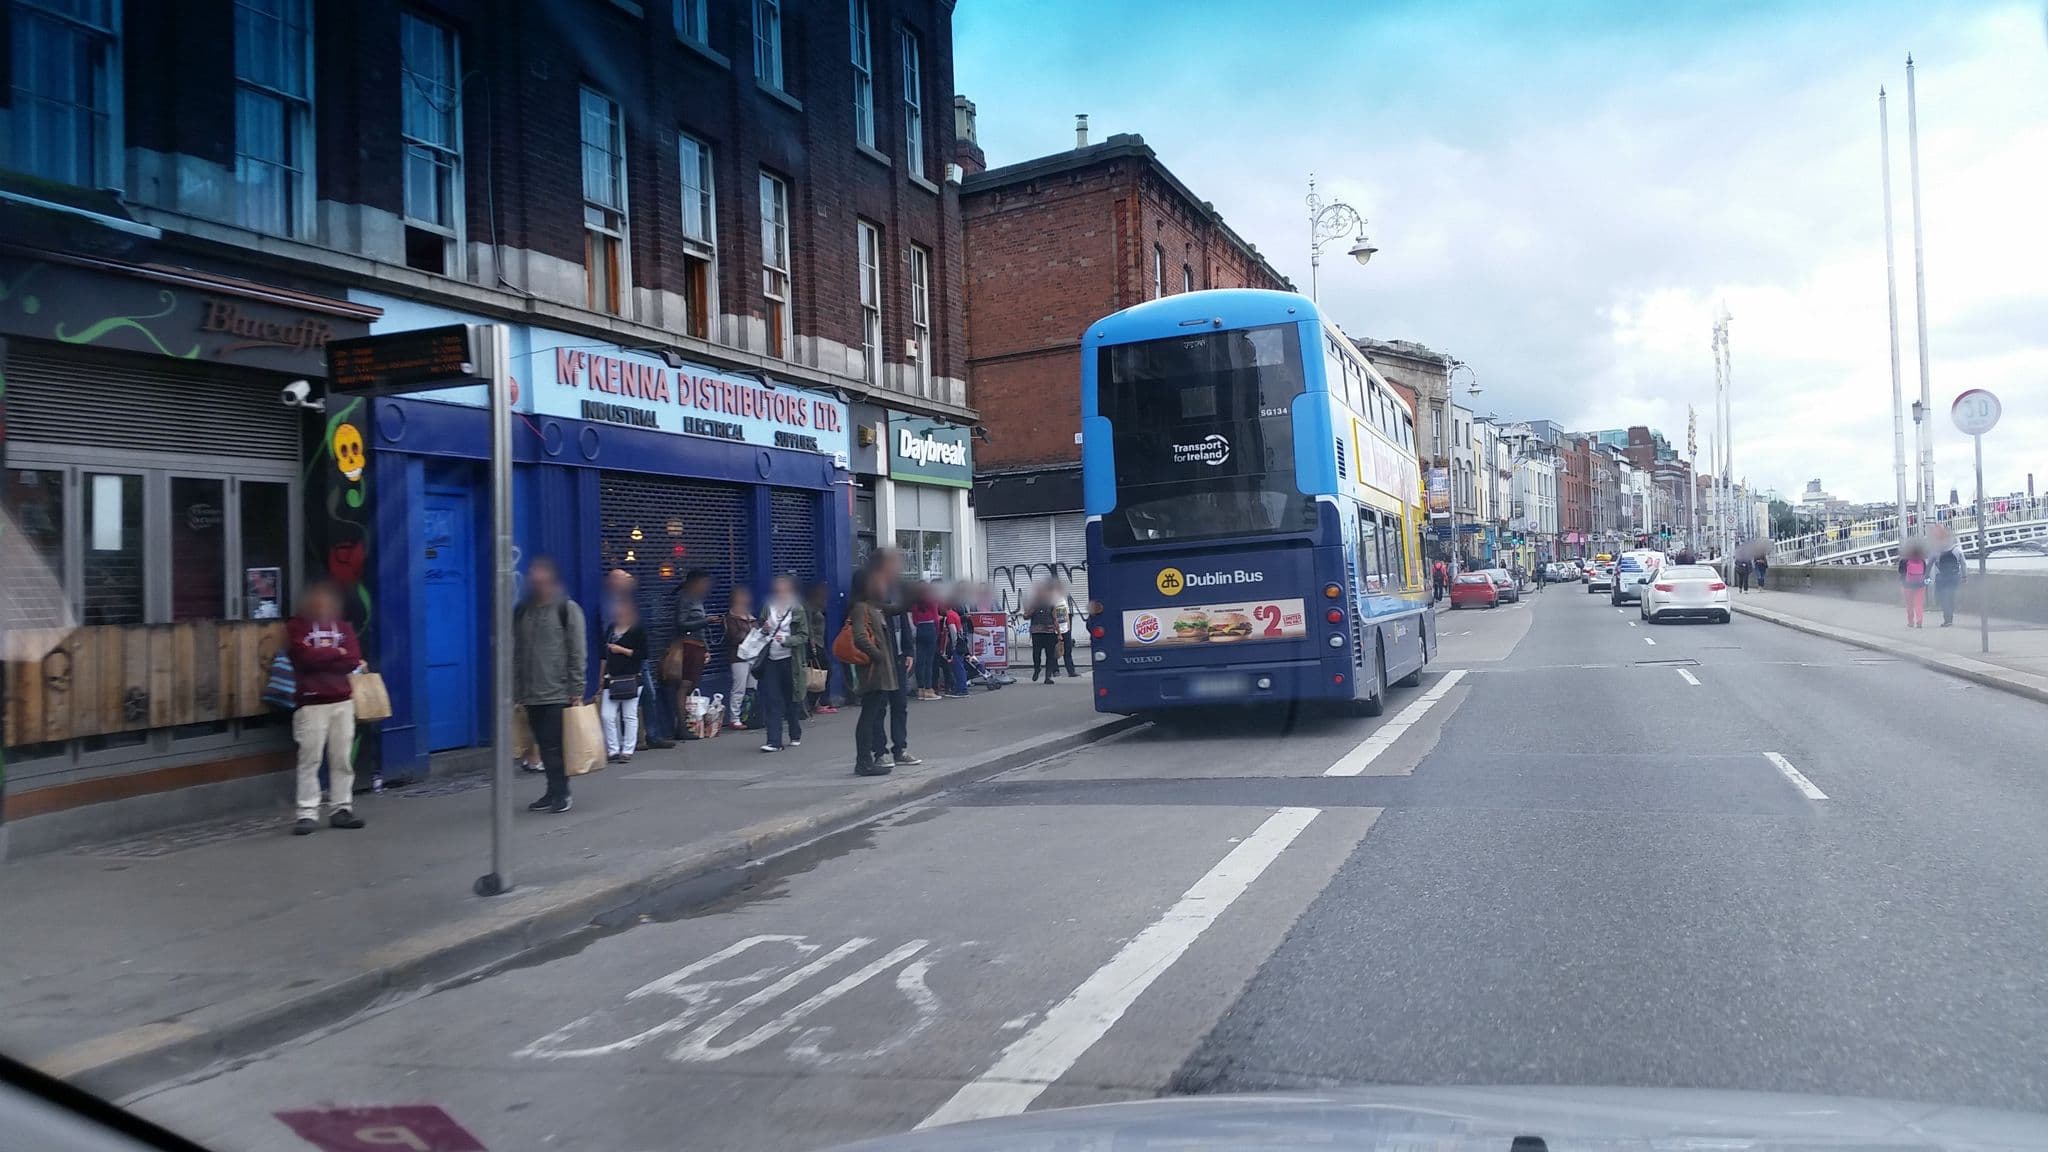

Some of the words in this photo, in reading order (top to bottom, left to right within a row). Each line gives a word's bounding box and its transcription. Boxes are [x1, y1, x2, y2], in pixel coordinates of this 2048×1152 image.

[677, 371, 808, 427] DISTRIBUTORS
[813, 400, 842, 433] LTD.
[1260, 407, 1288, 417] SG134
[581, 399, 660, 429] INDUSTRIAL
[683, 416, 746, 442] ELECTRICAL
[774, 430, 819, 452] SUPPLIERS
[899, 428, 967, 467] Daybreak
[1172, 440, 1222, 453] Transport
[1173, 453, 1187, 463] for
[1187, 449, 1223, 461] Ireland
[1186, 571, 1232, 588] Dublin
[1234, 569, 1264, 584] Bus
[1135, 616, 1158, 630] BURGER
[1252, 604, 1283, 637] €2
[1137, 622, 1159, 637] KING
[1123, 655, 1163, 665] VOLVO
[509, 933, 943, 1065] BUS
